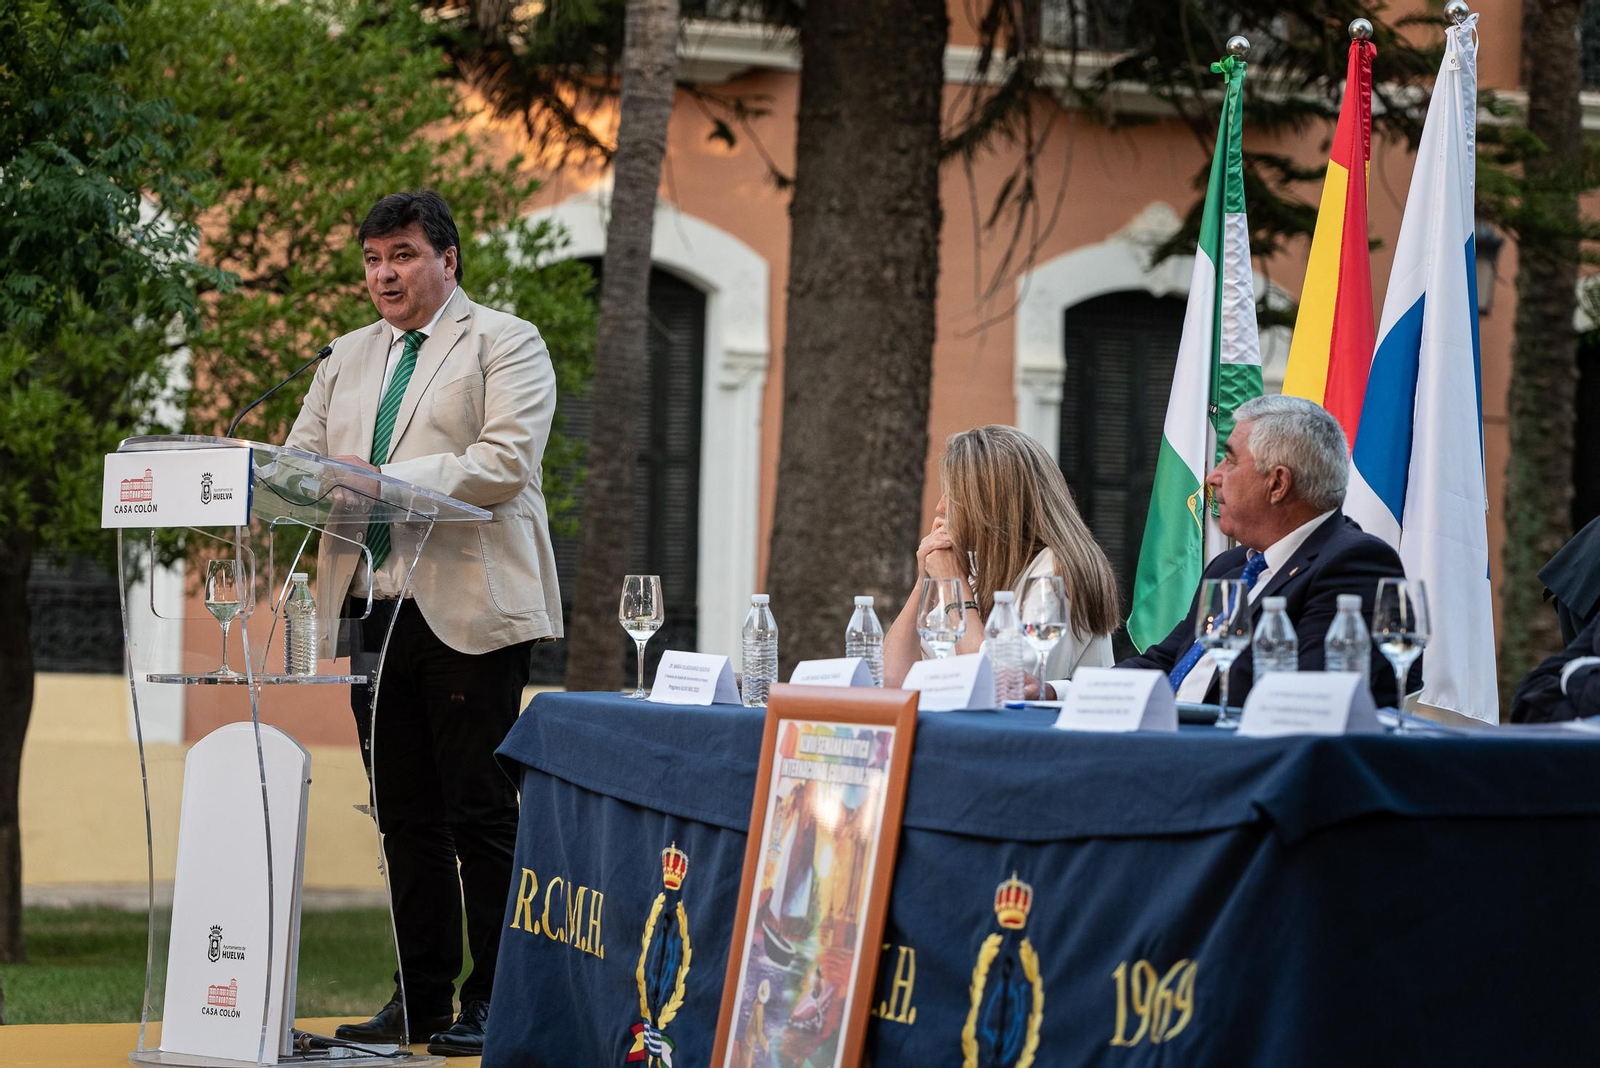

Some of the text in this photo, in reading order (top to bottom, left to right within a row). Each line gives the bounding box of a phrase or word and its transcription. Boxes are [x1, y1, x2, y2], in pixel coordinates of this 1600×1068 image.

[213, 492, 233, 500] HUELVA
[114, 502, 158, 514] CASA COLÓN
[222, 951, 245, 960] HUELVA
[1110, 958, 1198, 1047] 1969
[201, 1007, 240, 1018] CASA COLÓN
